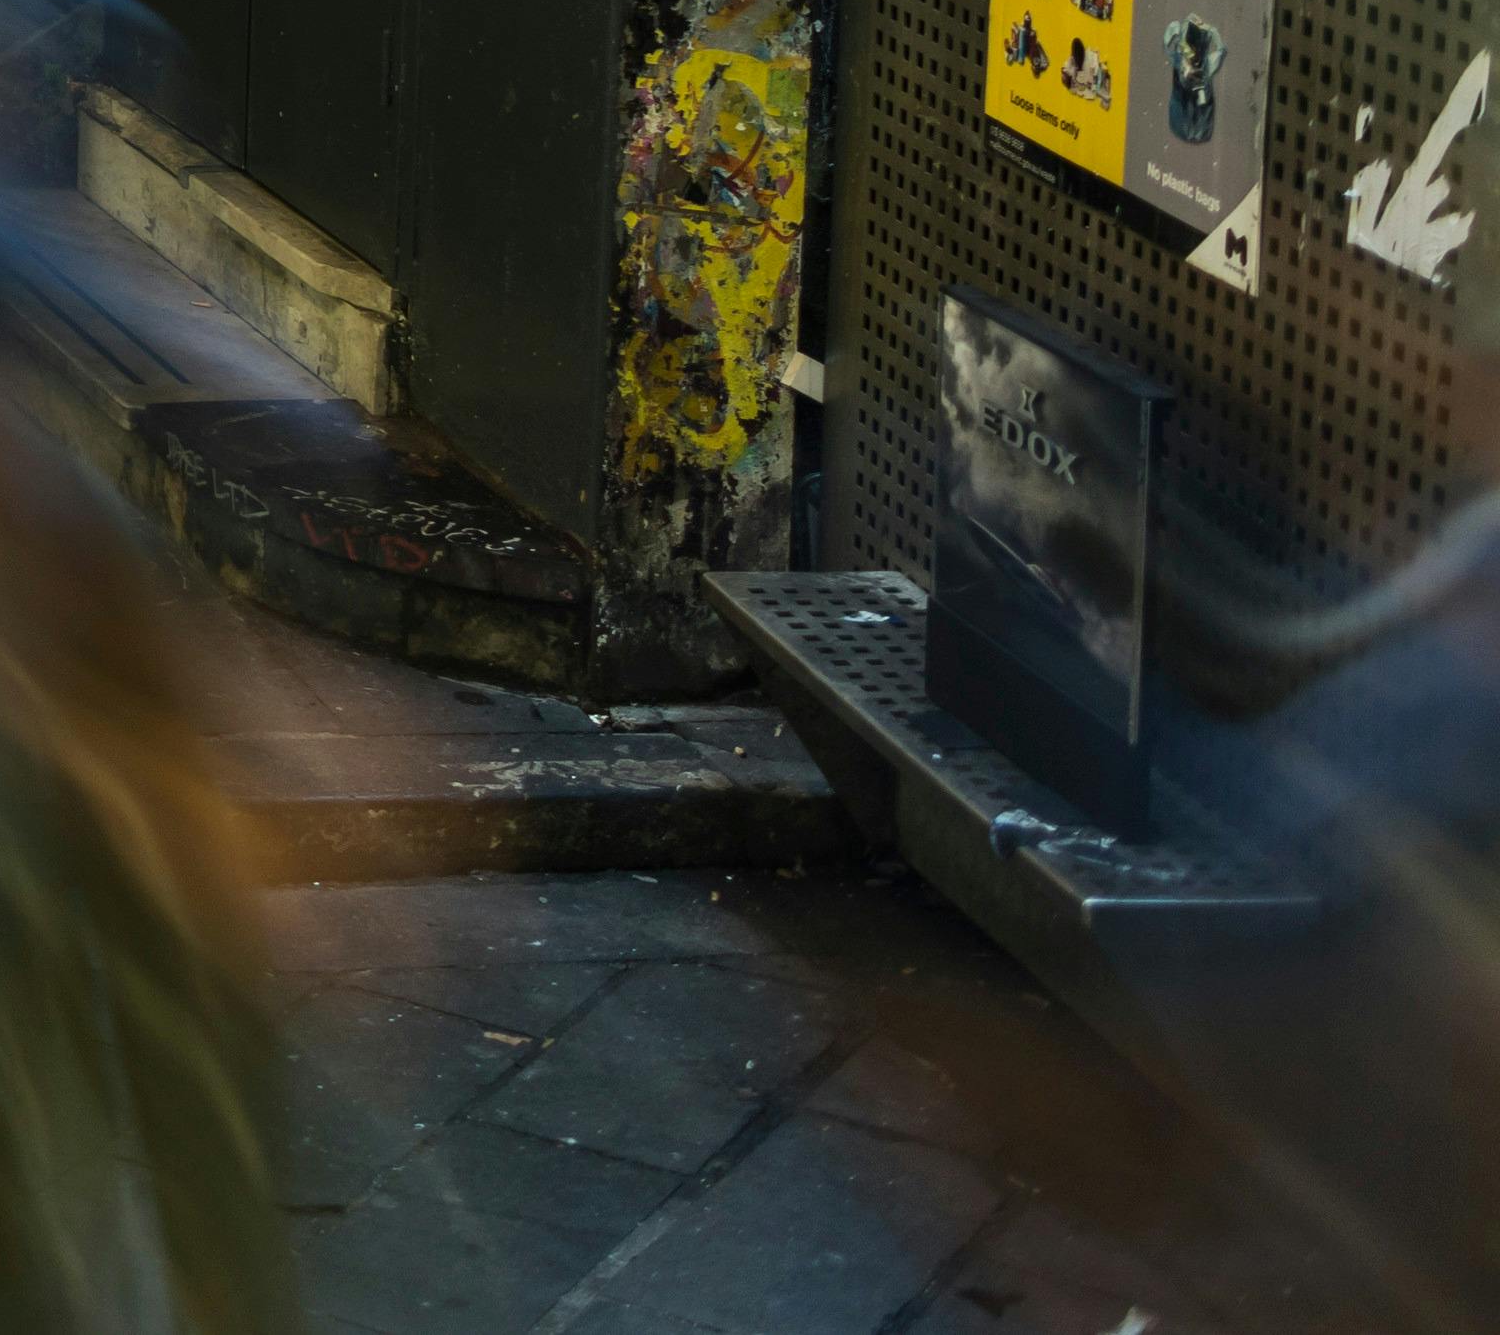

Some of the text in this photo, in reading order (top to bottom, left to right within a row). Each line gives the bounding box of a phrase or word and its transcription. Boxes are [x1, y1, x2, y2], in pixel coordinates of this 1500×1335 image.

[1008, 89, 1081, 141] Loose items only
[1146, 161, 1222, 214] No plastic bags
[978, 397, 1077, 486] EDOX
